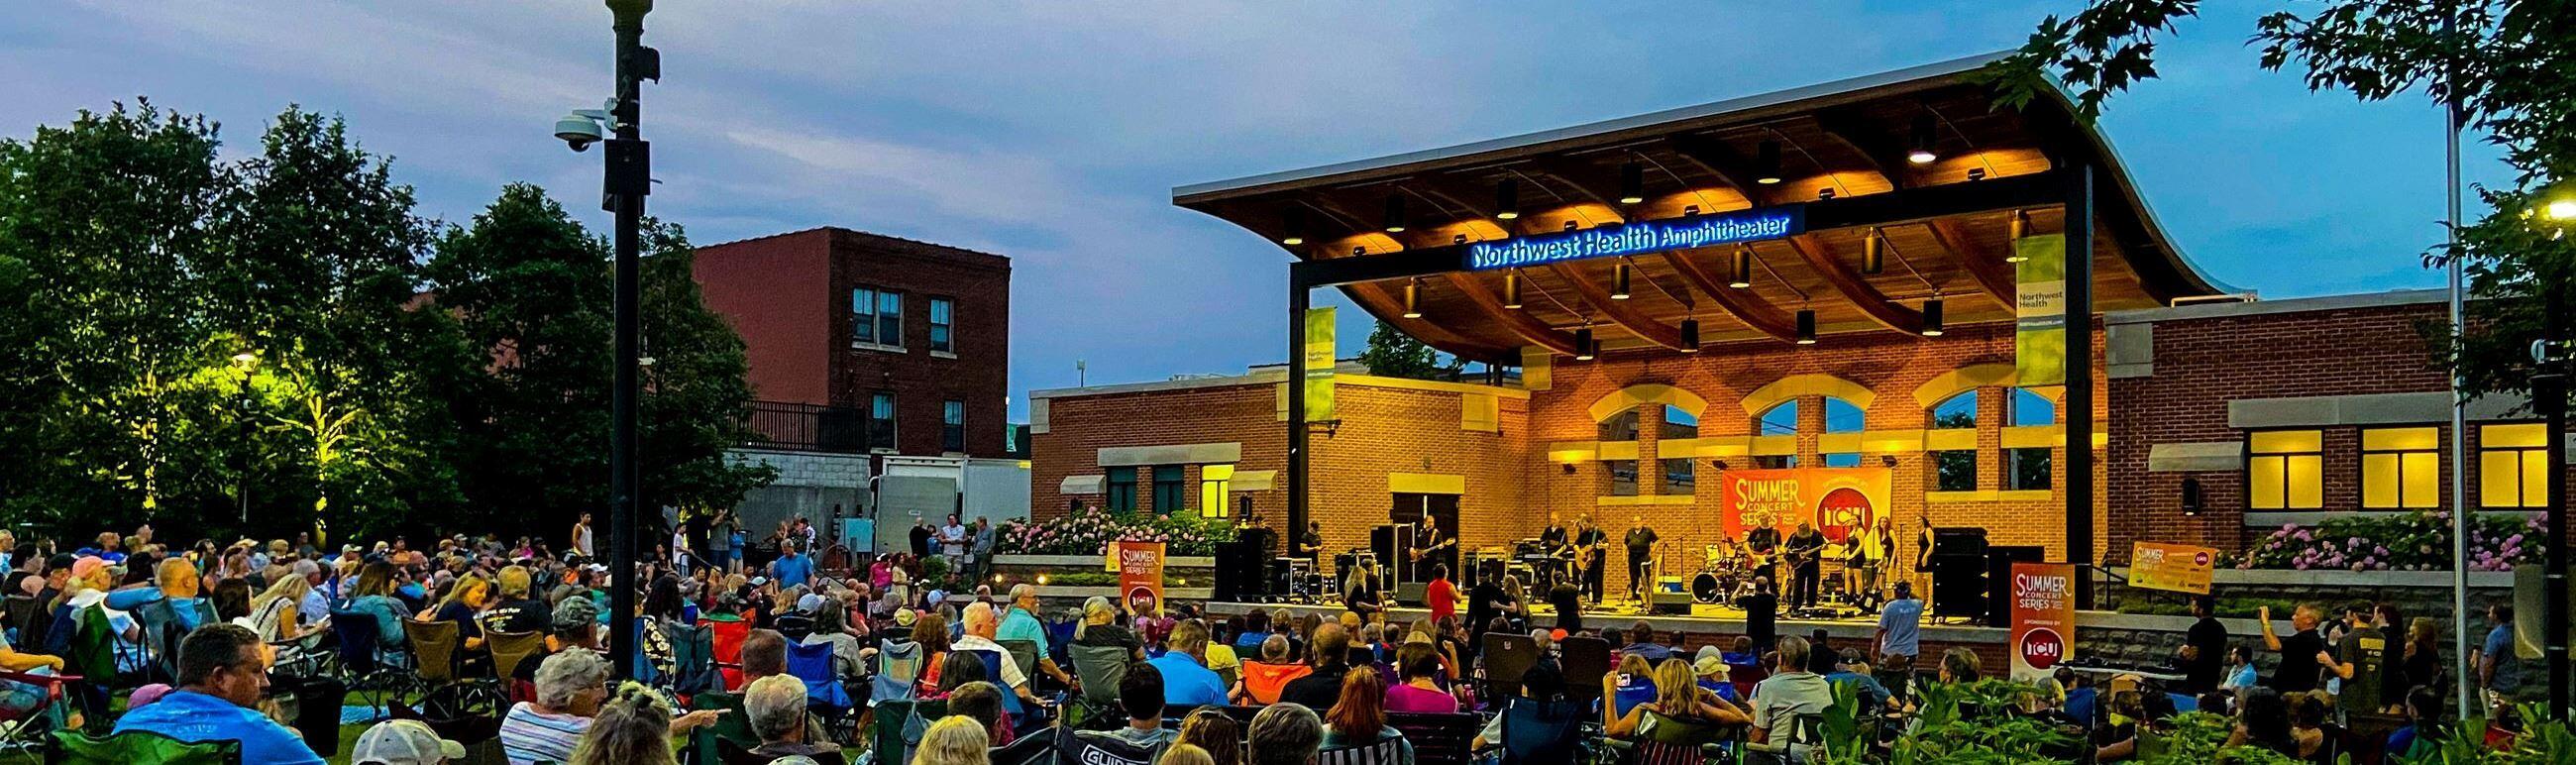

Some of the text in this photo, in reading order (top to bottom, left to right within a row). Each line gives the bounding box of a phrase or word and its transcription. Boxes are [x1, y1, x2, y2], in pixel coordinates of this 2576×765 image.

[1473, 217, 1789, 268] Northwest Health Amphitheater
[2019, 291, 2063, 300] Northwest
[2019, 299, 2047, 308] Health
[1736, 479, 1806, 510] SUMMER
[1747, 502, 1793, 512] CONCERT
[1740, 512, 1777, 526] SERS
[1123, 549, 1159, 566] SUMMER
[2136, 546, 2166, 563] SUMMER
[1126, 566, 1145, 575] SERIES
[2016, 574, 2072, 597] SUMMER
[2019, 599, 2049, 610] SERIES
[2027, 642, 2058, 656] TCU
[1088, 750, 1138, 765] GUID
